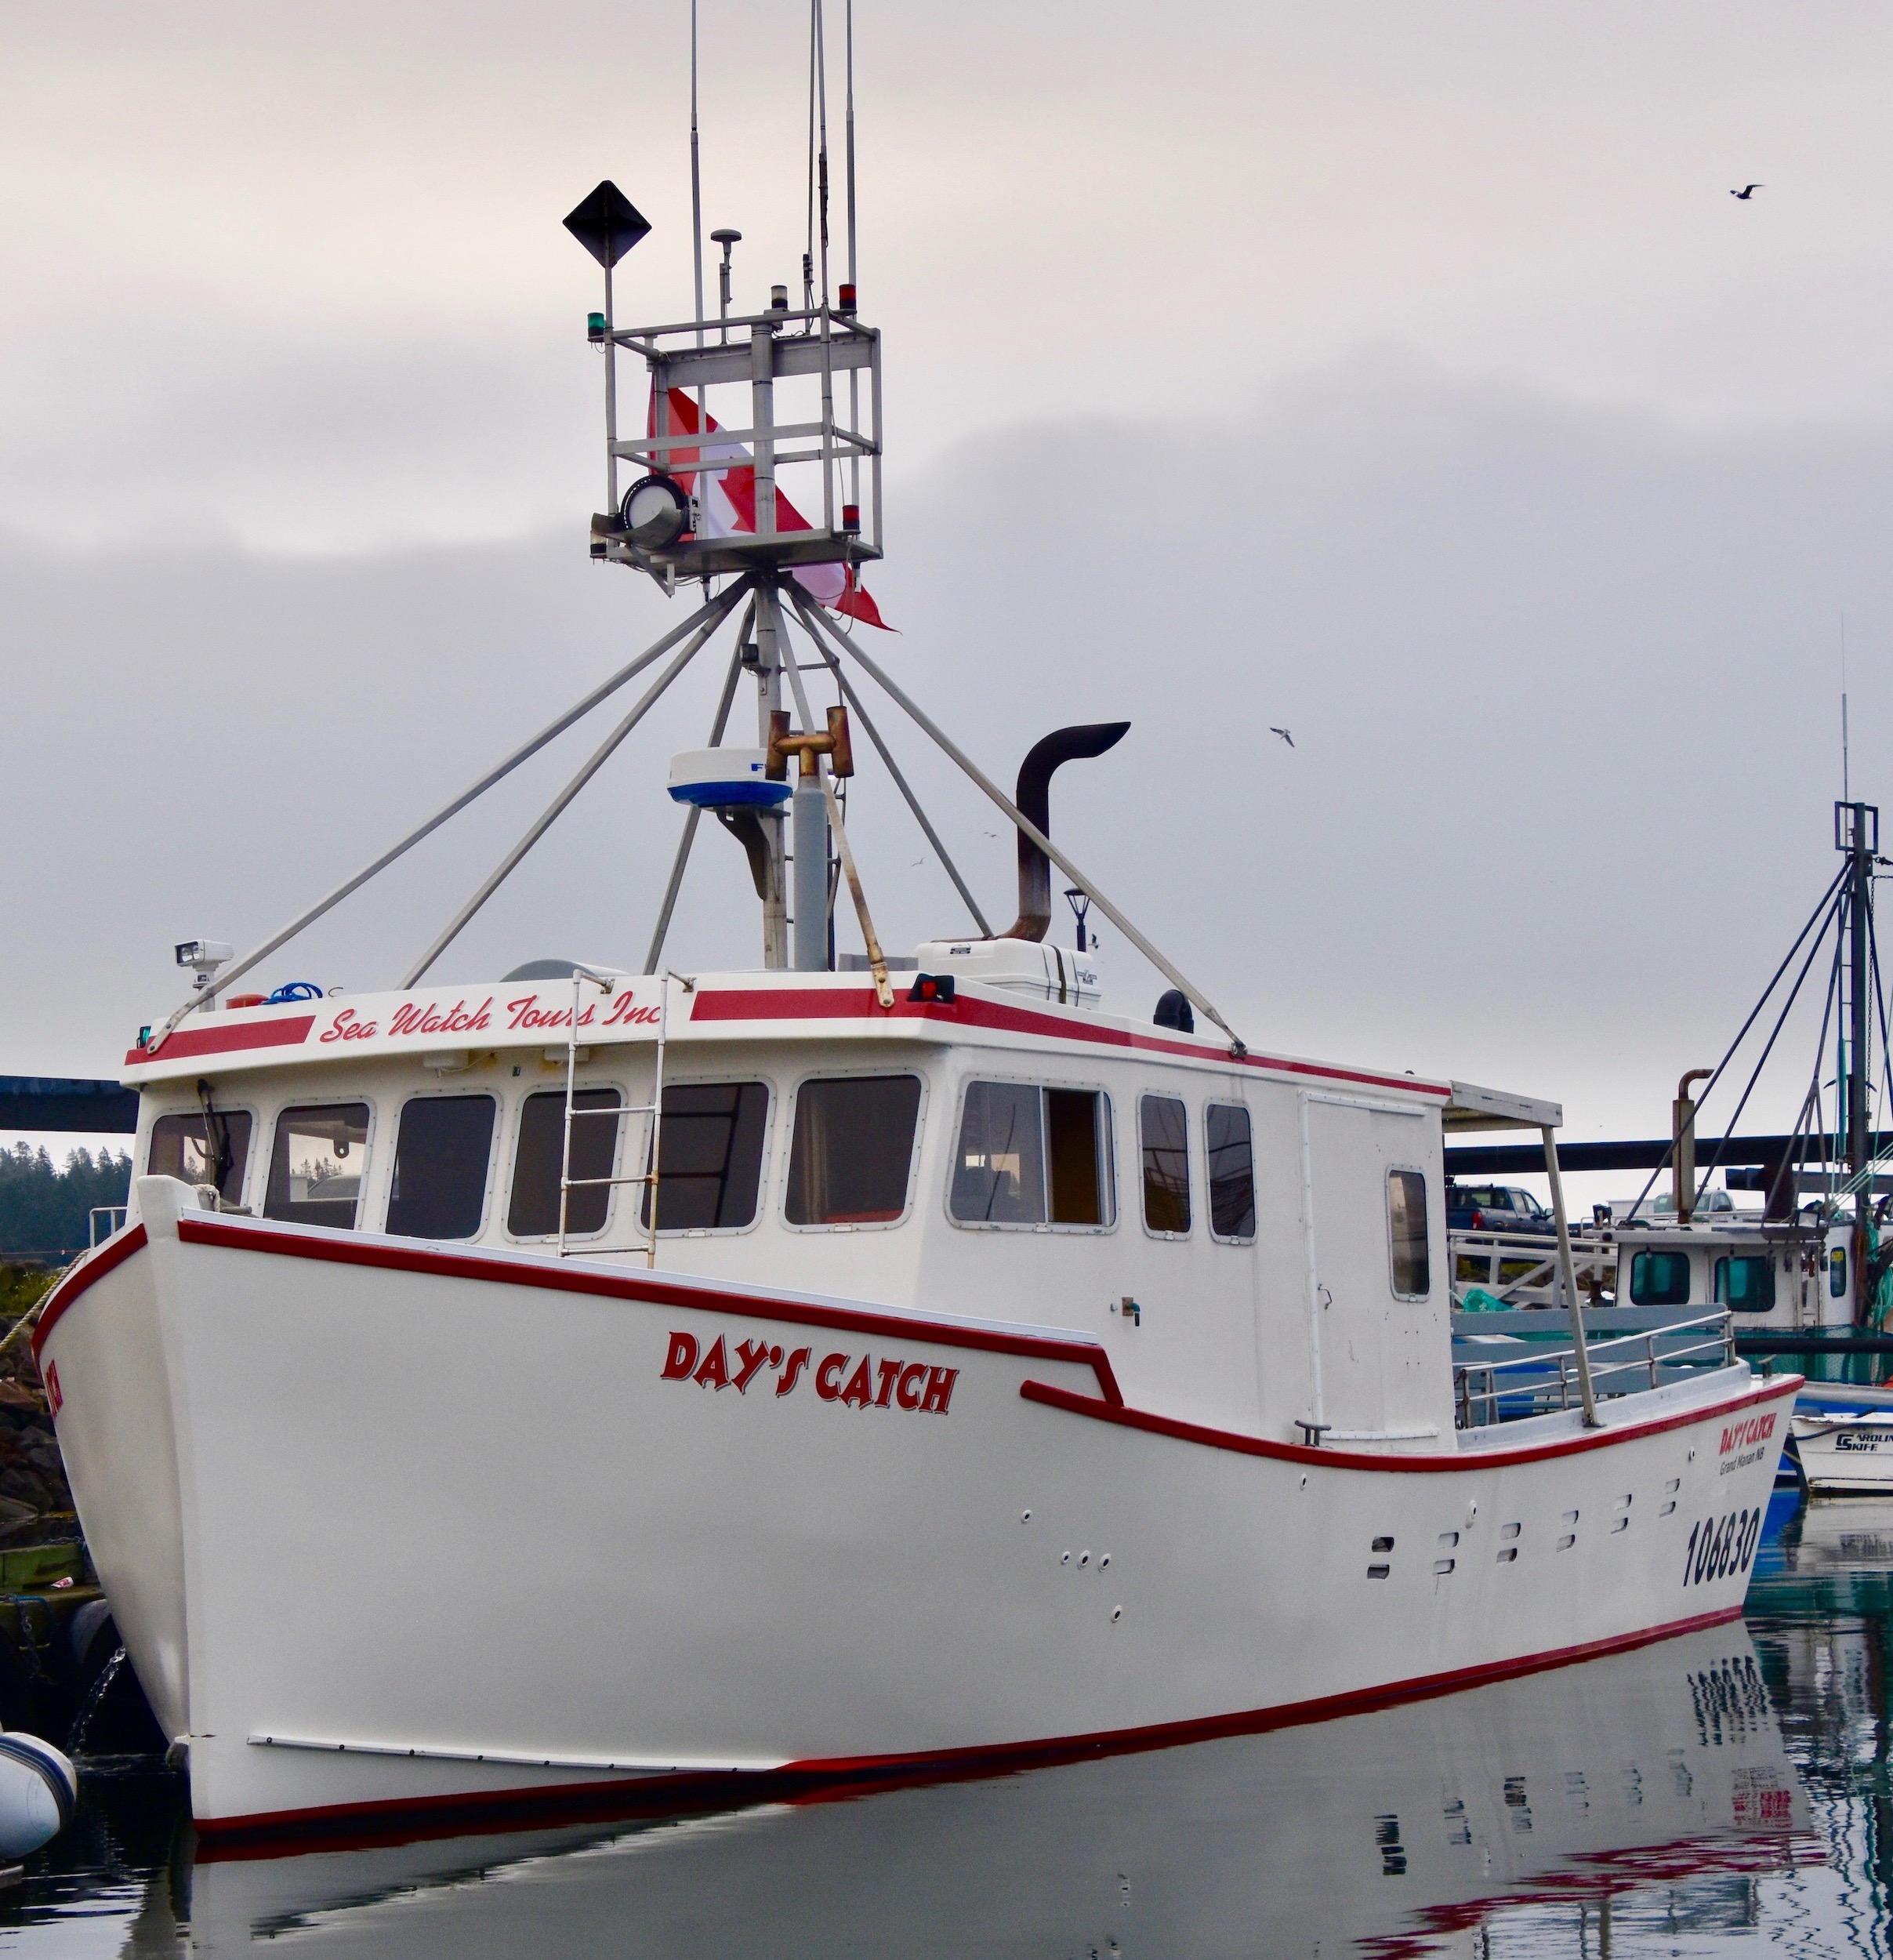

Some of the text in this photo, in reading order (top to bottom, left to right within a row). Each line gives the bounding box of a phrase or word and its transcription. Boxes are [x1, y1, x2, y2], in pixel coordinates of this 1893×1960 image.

[319, 1008, 379, 1044] Sea
[388, 996, 495, 1036] Watch
[507, 994, 596, 1029] Tours
[660, 1331, 959, 1415] DAY'S CATCH
[1746, 1413, 1777, 1446] CATCH
[1720, 1446, 1765, 1475] Grand Manan NB
[1683, 1507, 1761, 1588] 106830
